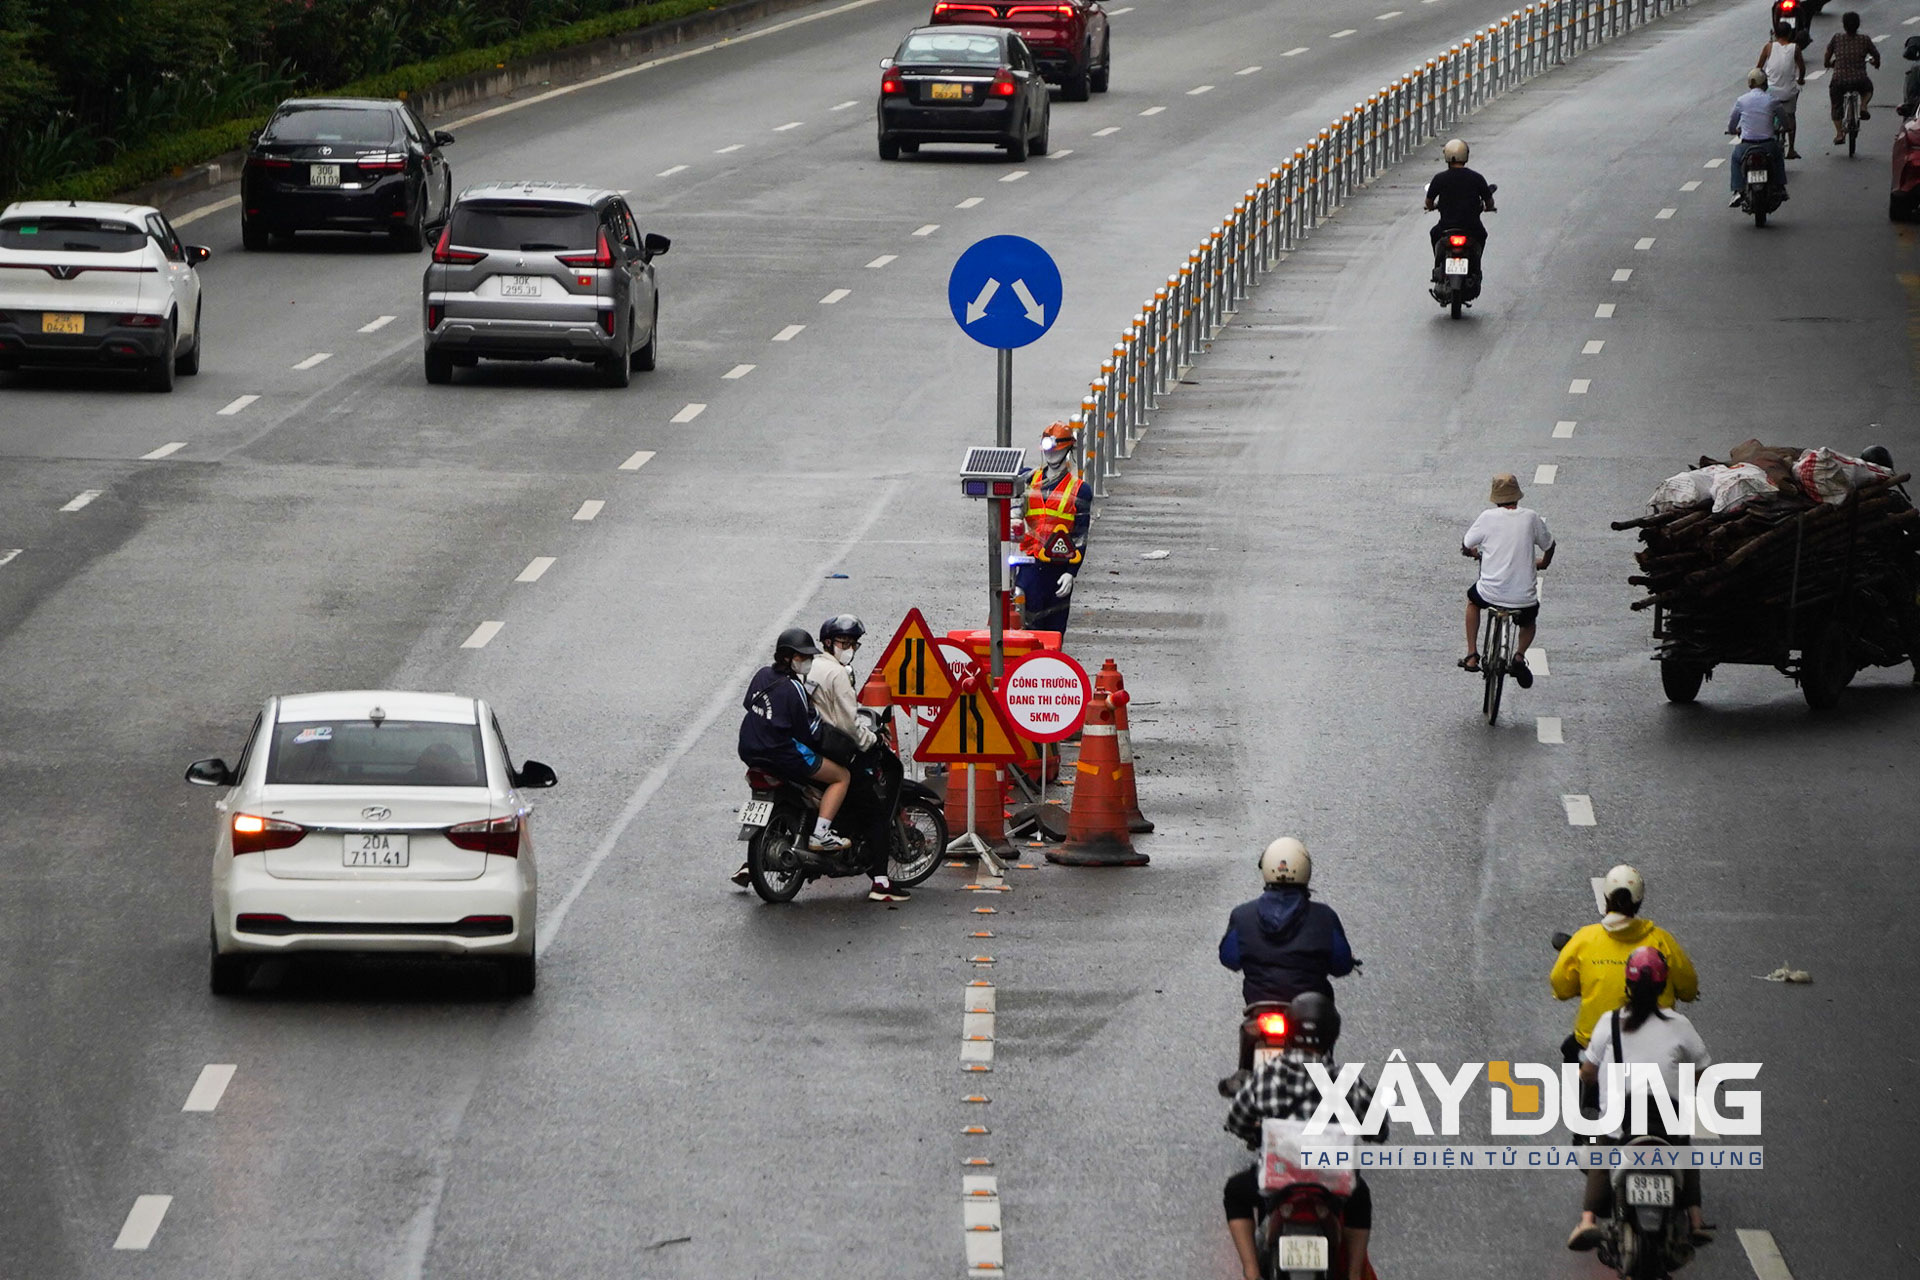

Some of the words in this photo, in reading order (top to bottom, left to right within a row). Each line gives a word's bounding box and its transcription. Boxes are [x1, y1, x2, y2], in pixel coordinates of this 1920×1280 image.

[1012, 676, 1038, 689] CÔNG
[1040, 676, 1078, 689] TRƯỜNG
[1009, 695, 1035, 705] ĐANG
[1037, 695, 1052, 705] THI
[1055, 693, 1080, 705] CÔNG
[1030, 712, 1060, 722] 5KM/h
[741, 814, 764, 823] 3421
[362, 836, 390, 849] 20A
[351, 851, 400, 864] 711.41
